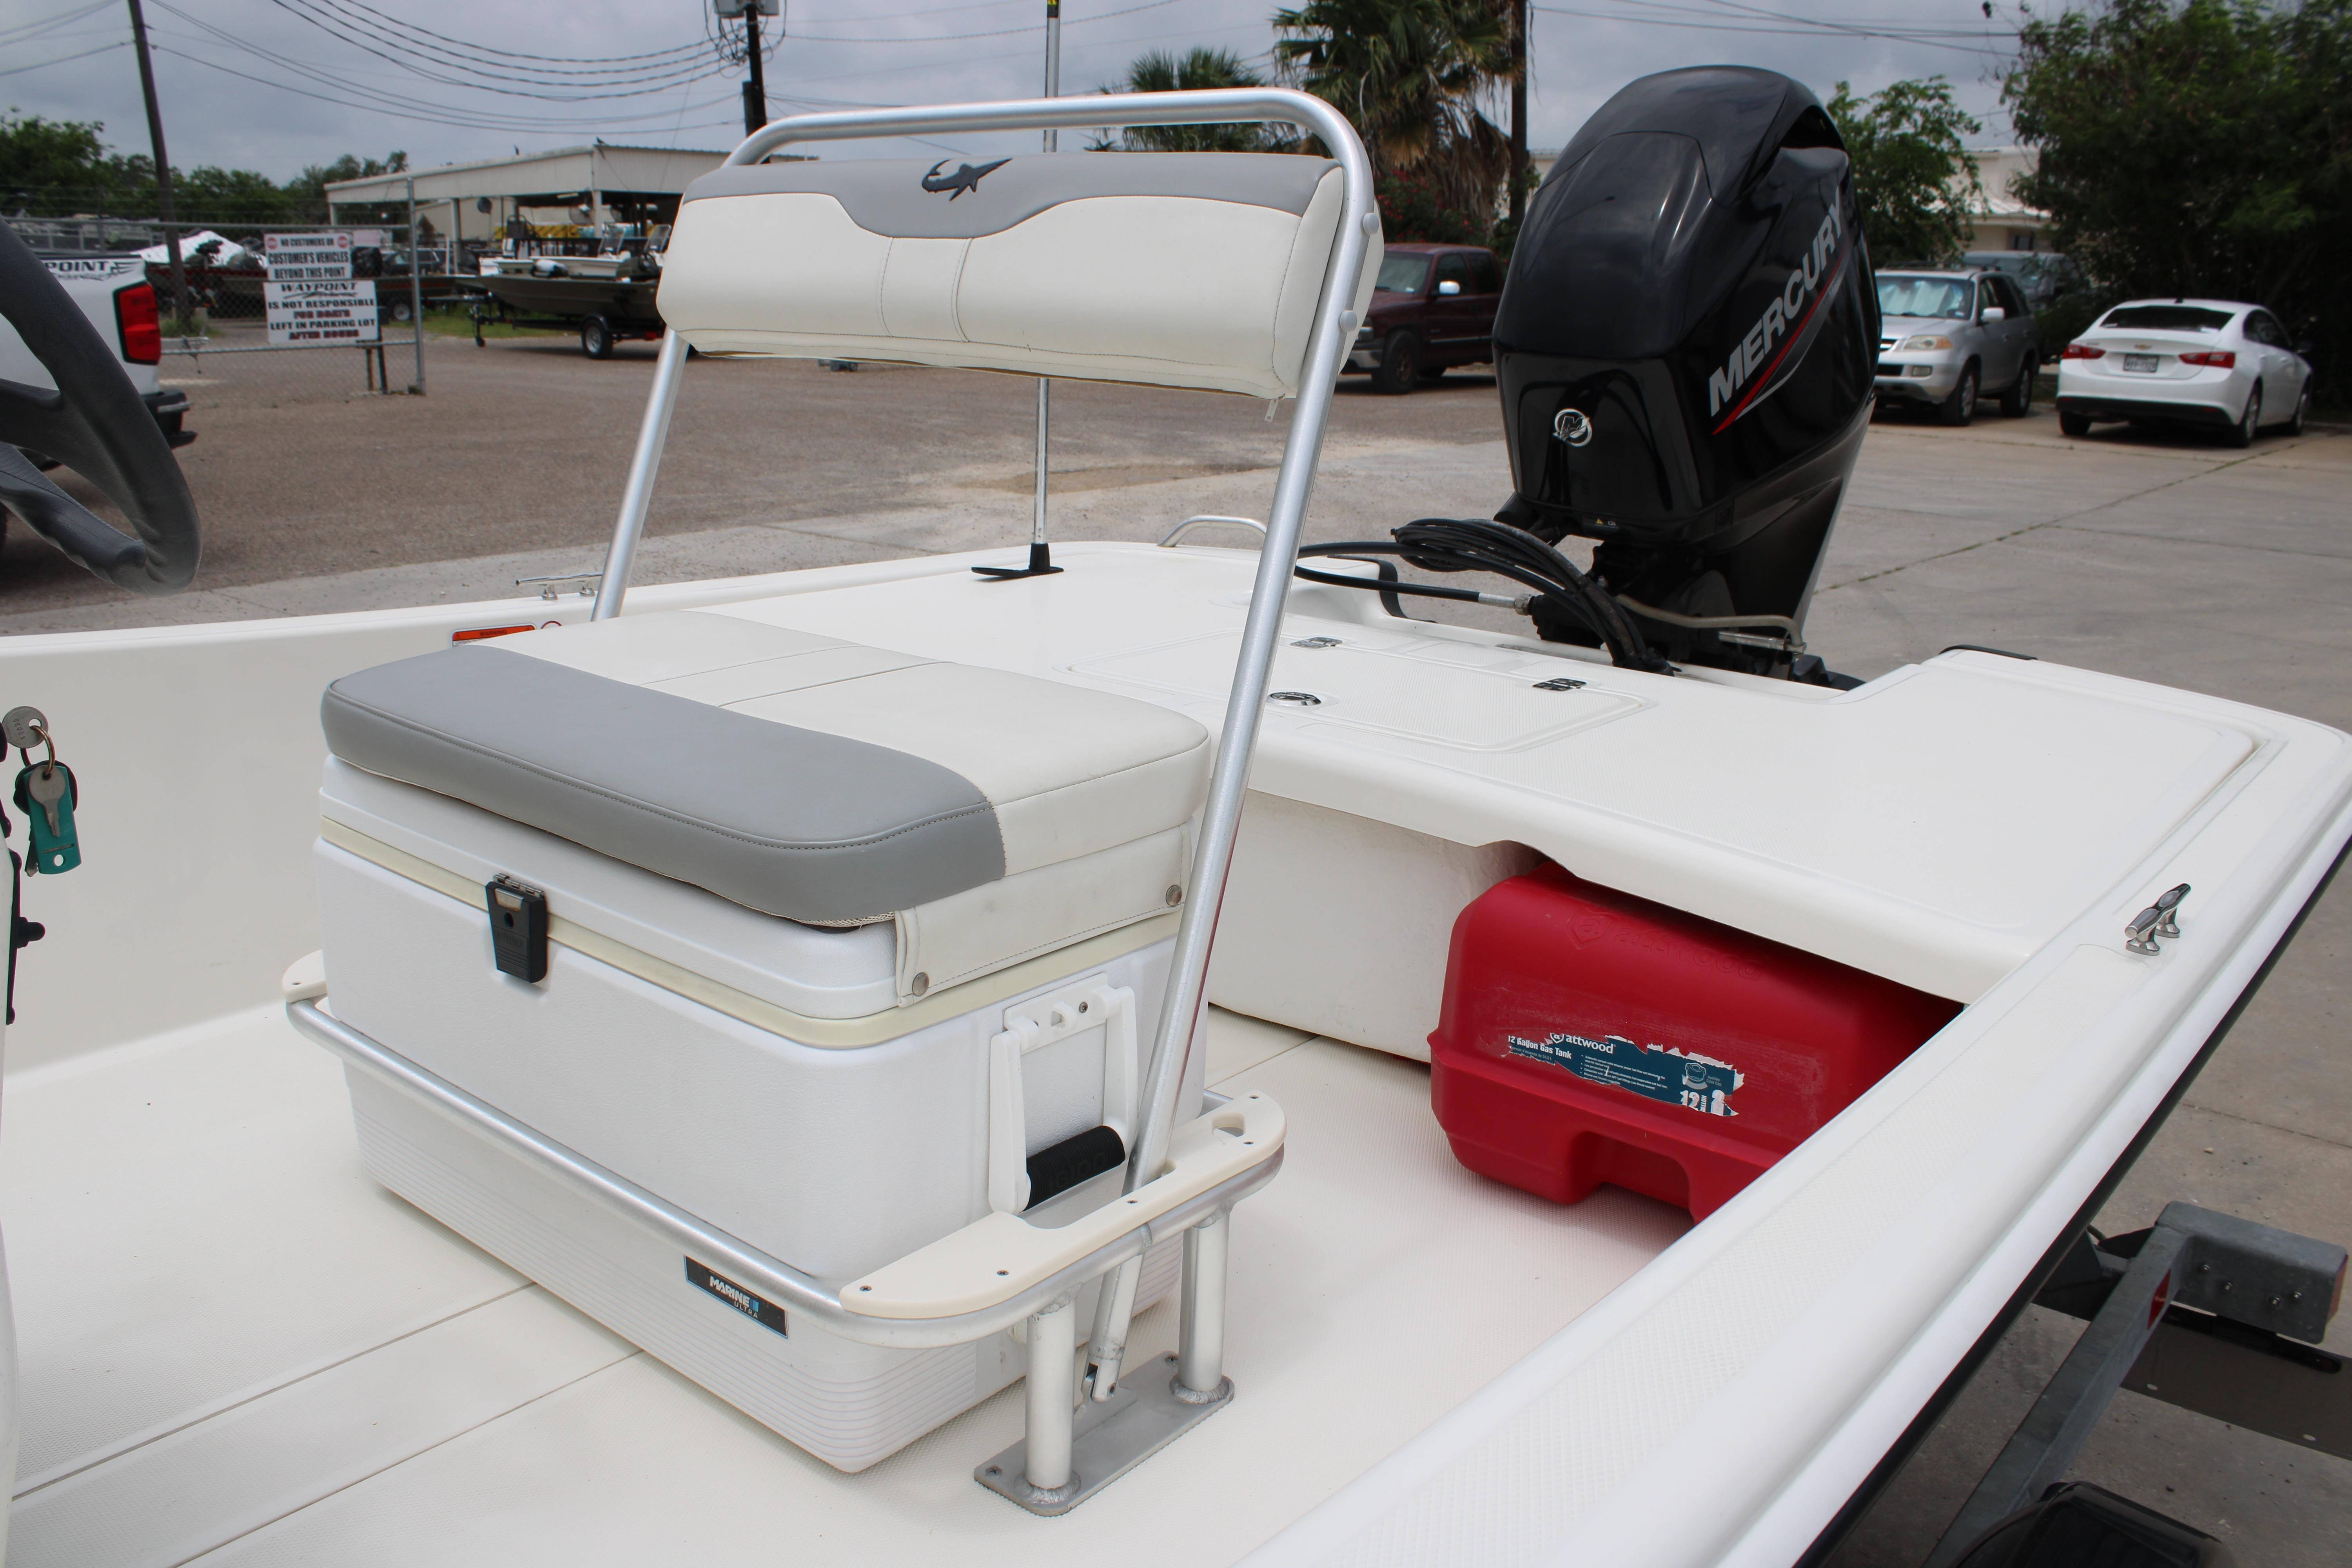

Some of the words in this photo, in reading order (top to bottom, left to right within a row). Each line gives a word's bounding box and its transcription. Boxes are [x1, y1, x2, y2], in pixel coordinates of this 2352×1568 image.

[290, 238, 325, 246] CUSTOMERS
[327, 237, 334, 246] OR
[269, 252, 314, 264] CUSTOMER'S
[316, 251, 349, 263] VEHICLES
[45, 261, 109, 271] POINT
[275, 268, 304, 279] BEYOND
[306, 268, 322, 278] THIS
[324, 267, 345, 277] POINT
[281, 282, 357, 292] WAYPOINT
[306, 298, 374, 308] RESPONSIBLE
[1709, 186, 1842, 417] MERCURY
[309, 319, 356, 328] PARKING
[1508, 1035, 1515, 1044] 12
[1540, 1043, 1553, 1054] Gas
[1555, 1047, 1572, 1059] Tank
[1565, 1034, 1613, 1054] attwood
[710, 1276, 750, 1307] MARINE
[734, 1300, 758, 1319] ULTRA
